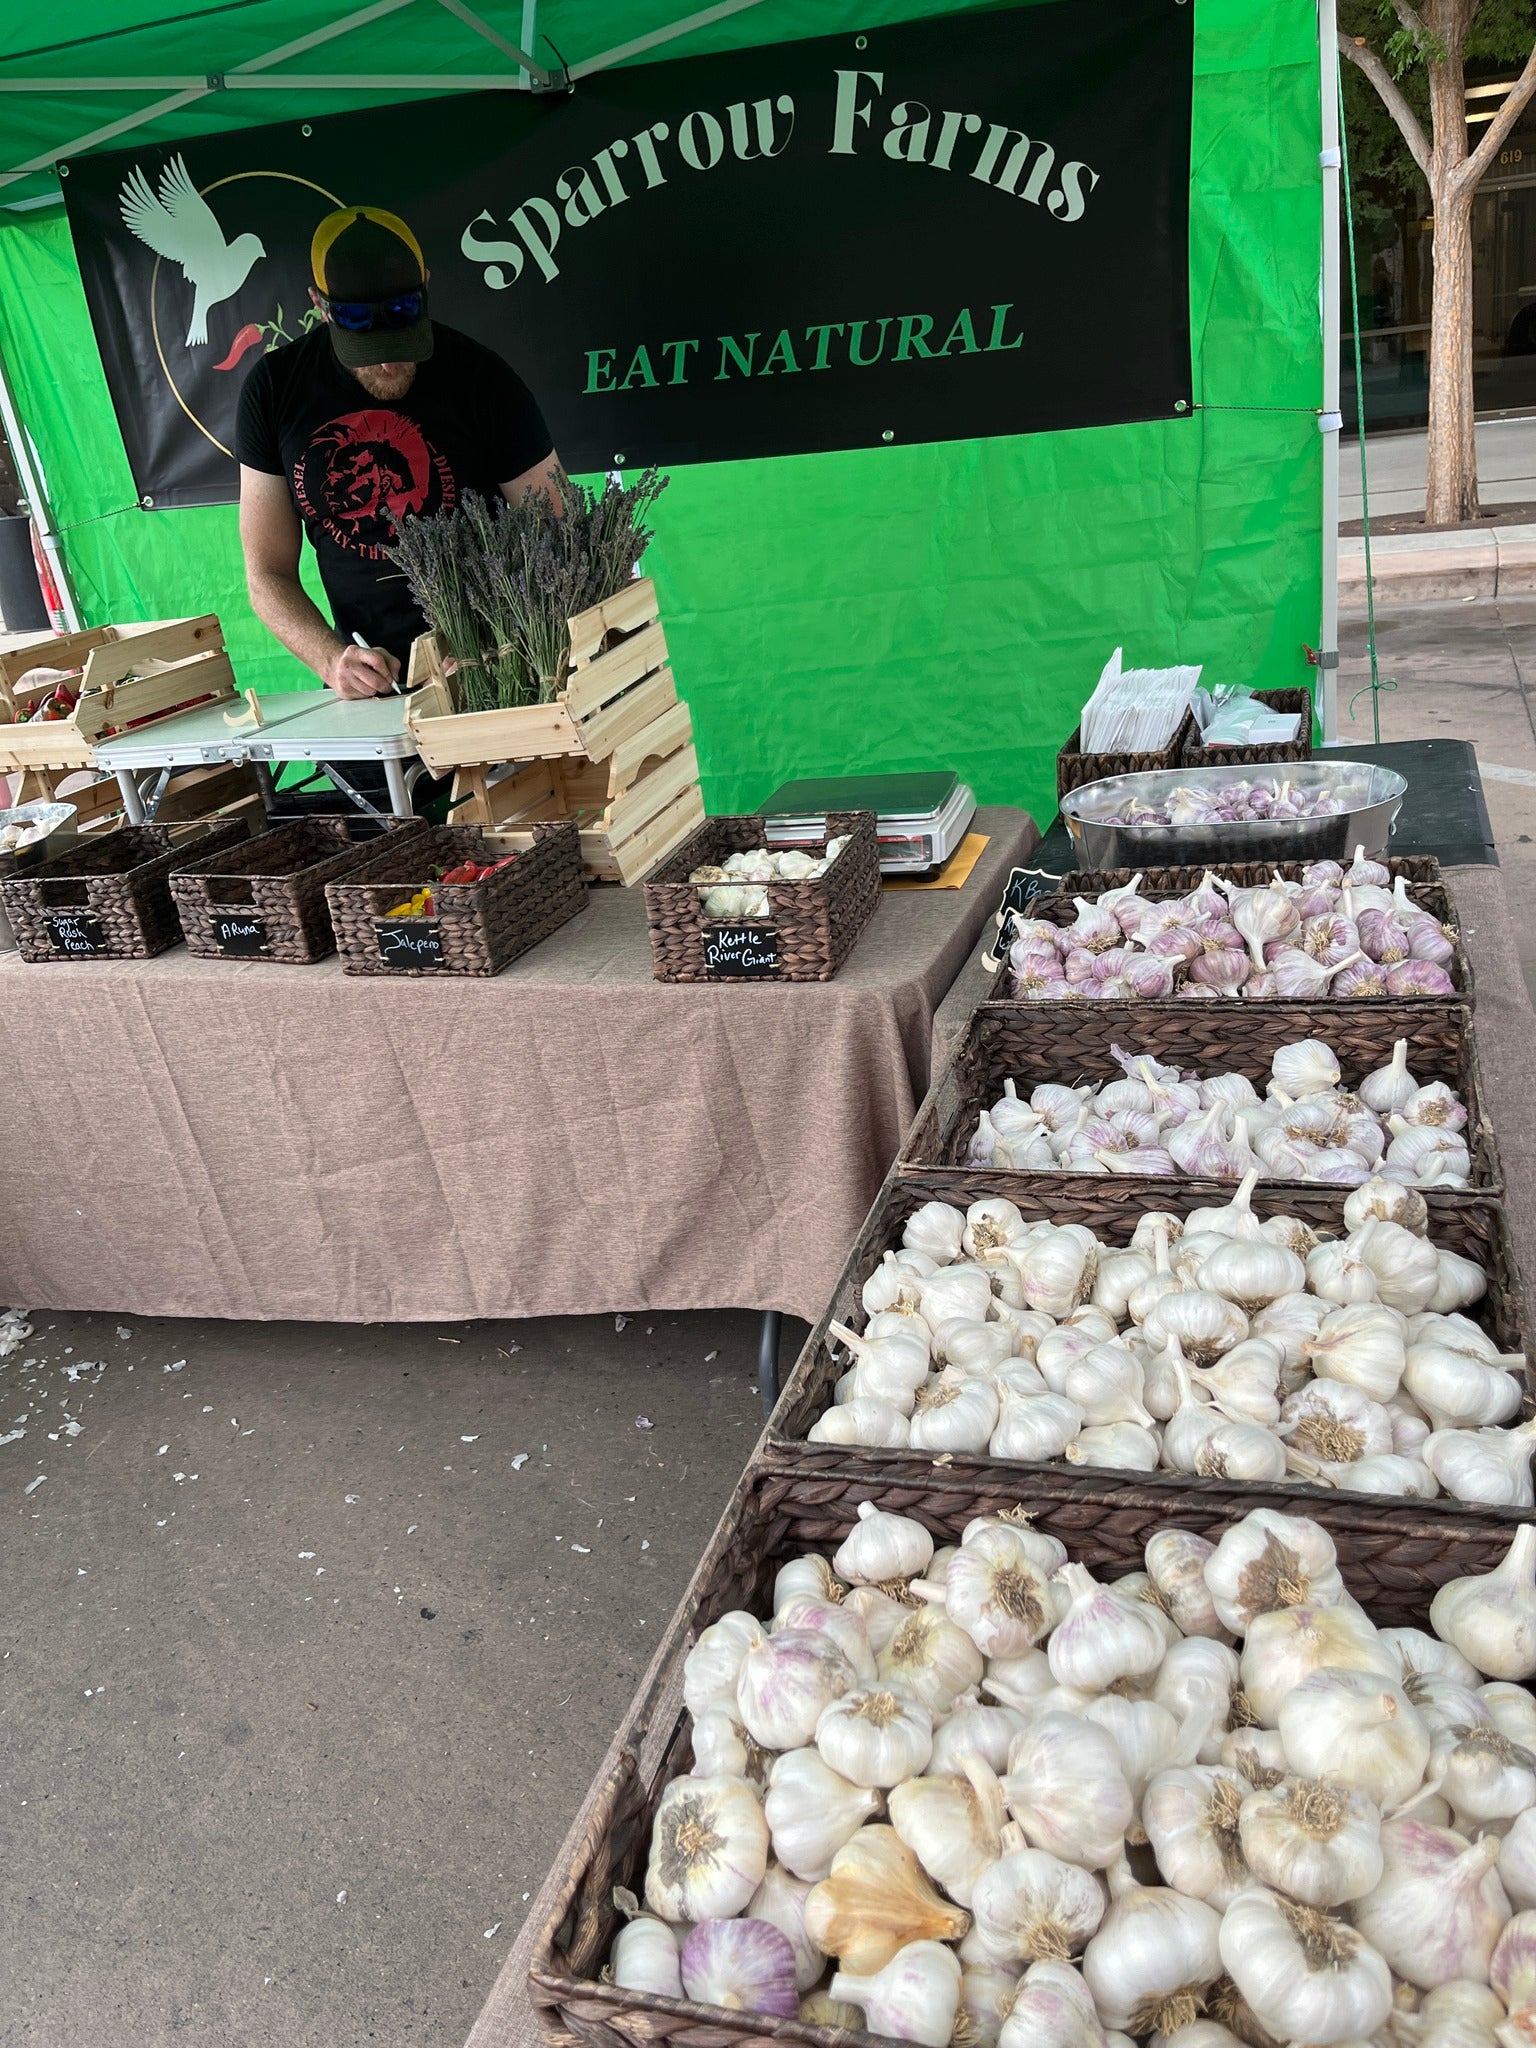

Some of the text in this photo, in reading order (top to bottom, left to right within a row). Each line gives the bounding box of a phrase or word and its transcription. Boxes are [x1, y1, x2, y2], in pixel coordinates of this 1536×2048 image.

[1500, 149, 1523, 165] 619
[460, 69, 1101, 290] Sparrow Farms
[582, 303, 1025, 394] EAT NATURAL
[52, 916, 80, 932] Sugar
[64, 938, 96, 951] Peach
[719, 930, 763, 949] Kettle
[706, 944, 777, 967] River Giant
